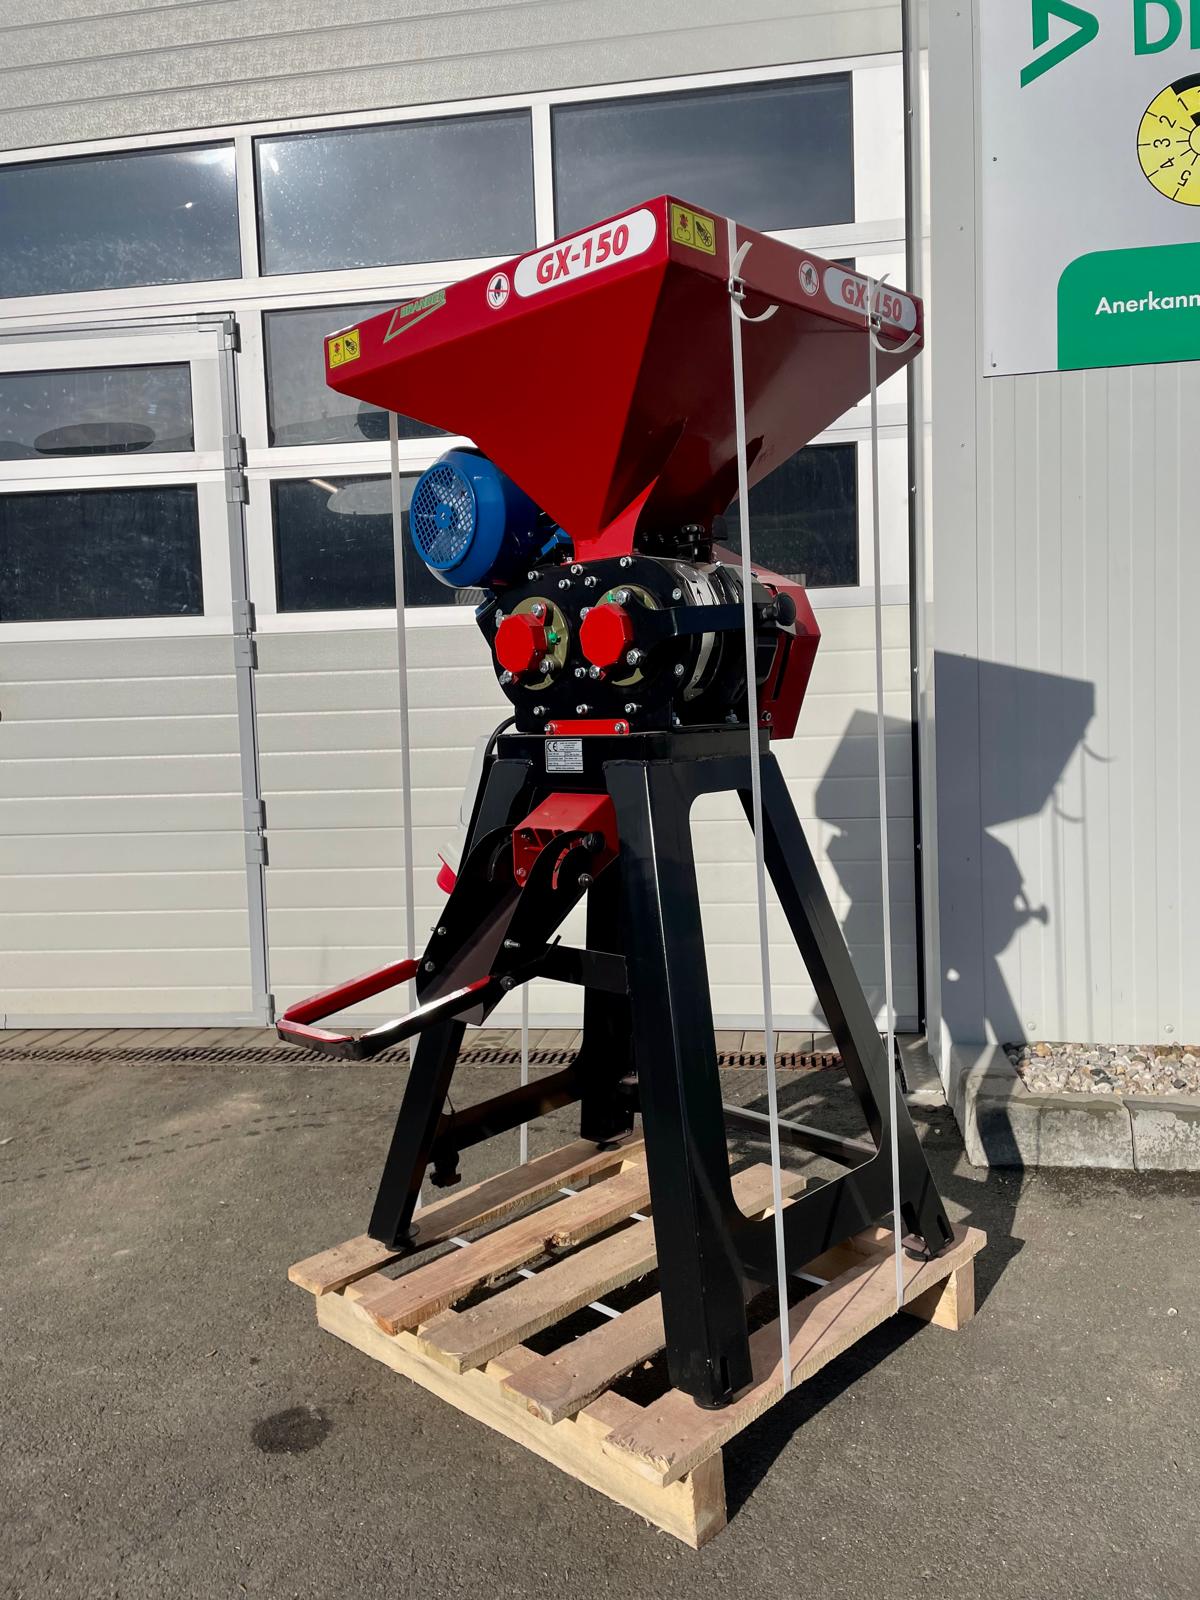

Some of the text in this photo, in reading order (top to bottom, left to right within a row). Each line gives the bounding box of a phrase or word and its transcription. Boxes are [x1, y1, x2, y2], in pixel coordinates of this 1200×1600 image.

[1158, 115, 1178, 129] 2
[1153, 138, 1171, 149] 3
[1160, 157, 1176, 169] 4
[1177, 169, 1192, 187] 5
[536, 223, 630, 285] GX-150
[1095, 291, 1200, 316] Anerkann
